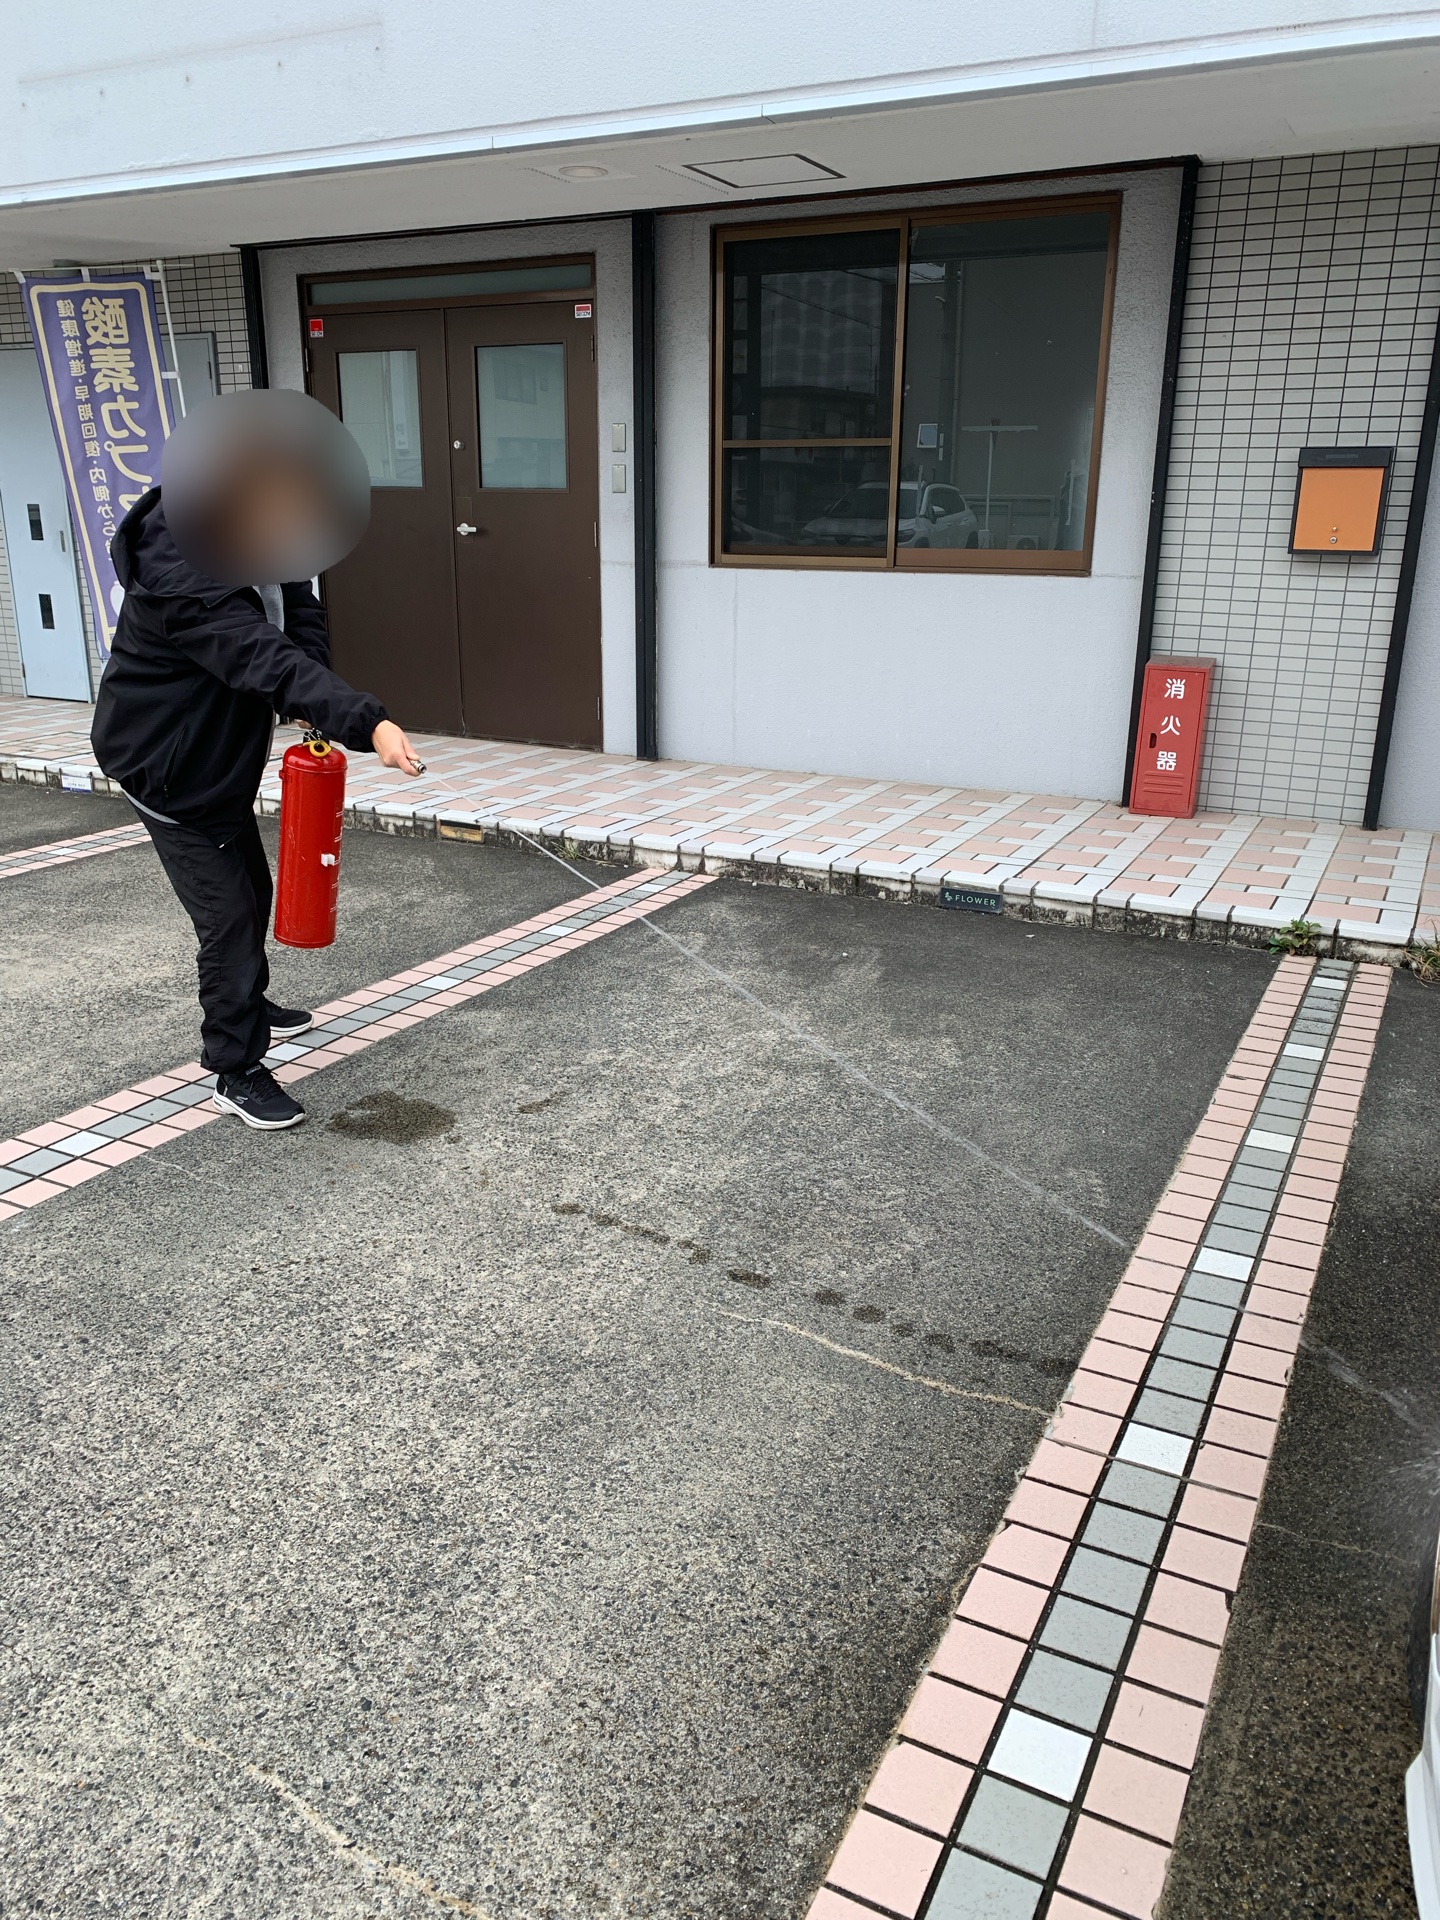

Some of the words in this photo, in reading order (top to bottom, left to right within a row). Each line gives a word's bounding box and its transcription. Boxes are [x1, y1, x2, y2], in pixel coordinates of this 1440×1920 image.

[1156, 678, 1186, 771] 消火器
[955, 894, 996, 907] FLOWER
